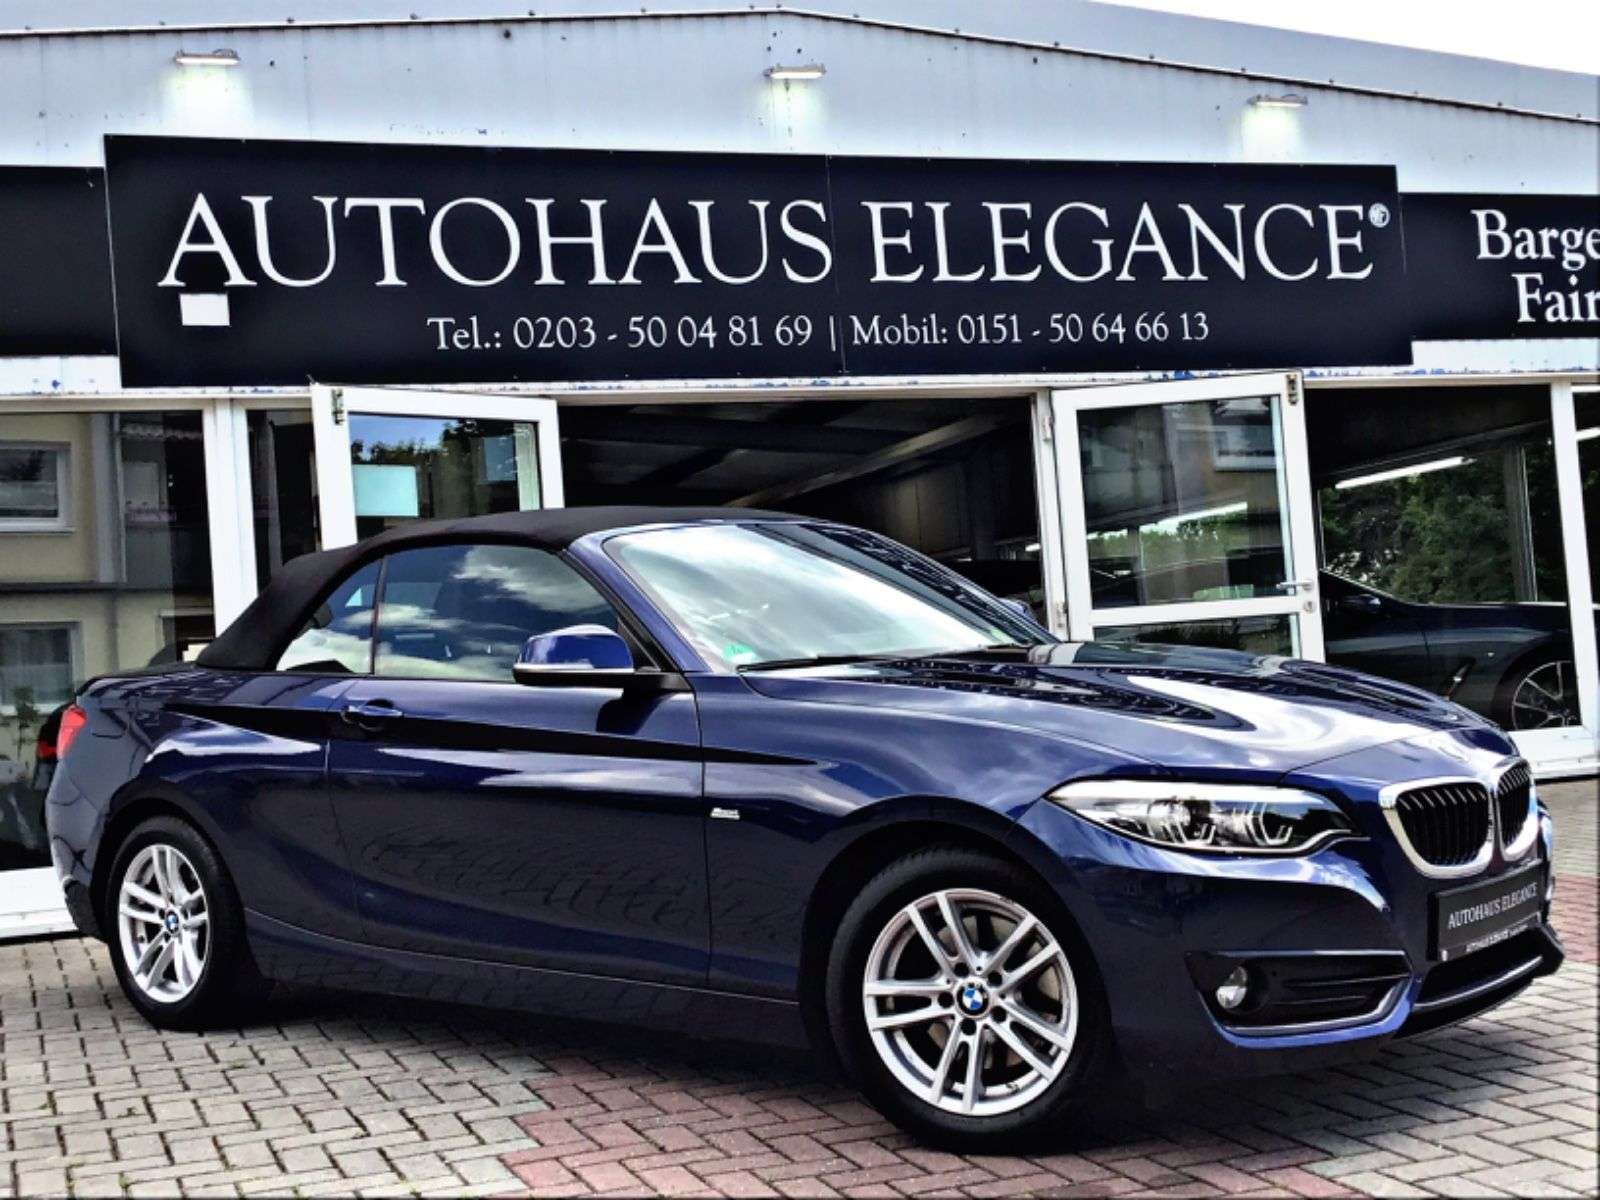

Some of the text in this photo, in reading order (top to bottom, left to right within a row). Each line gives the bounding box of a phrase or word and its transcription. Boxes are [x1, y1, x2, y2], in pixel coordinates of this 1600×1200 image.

[157, 192, 833, 287] AUTOHAUS
[1471, 209, 1600, 271] Barge
[426, 315, 502, 350] Tel.:
[512, 316, 597, 349] 0203
[628, 315, 668, 348] 50
[676, 315, 718, 348] 04
[727, 315, 764, 347] 81
[775, 315, 814, 346] 69
[849, 313, 949, 345] Mobil:
[957, 313, 1023, 344] 0151
[1049, 313, 1084, 342] 50
[1092, 313, 1127, 344] 64
[1134, 311, 1170, 341] 66
[1179, 311, 1210, 341] 13
[1448, 882, 1538, 930] AUTOHAUS ELEGANCE
